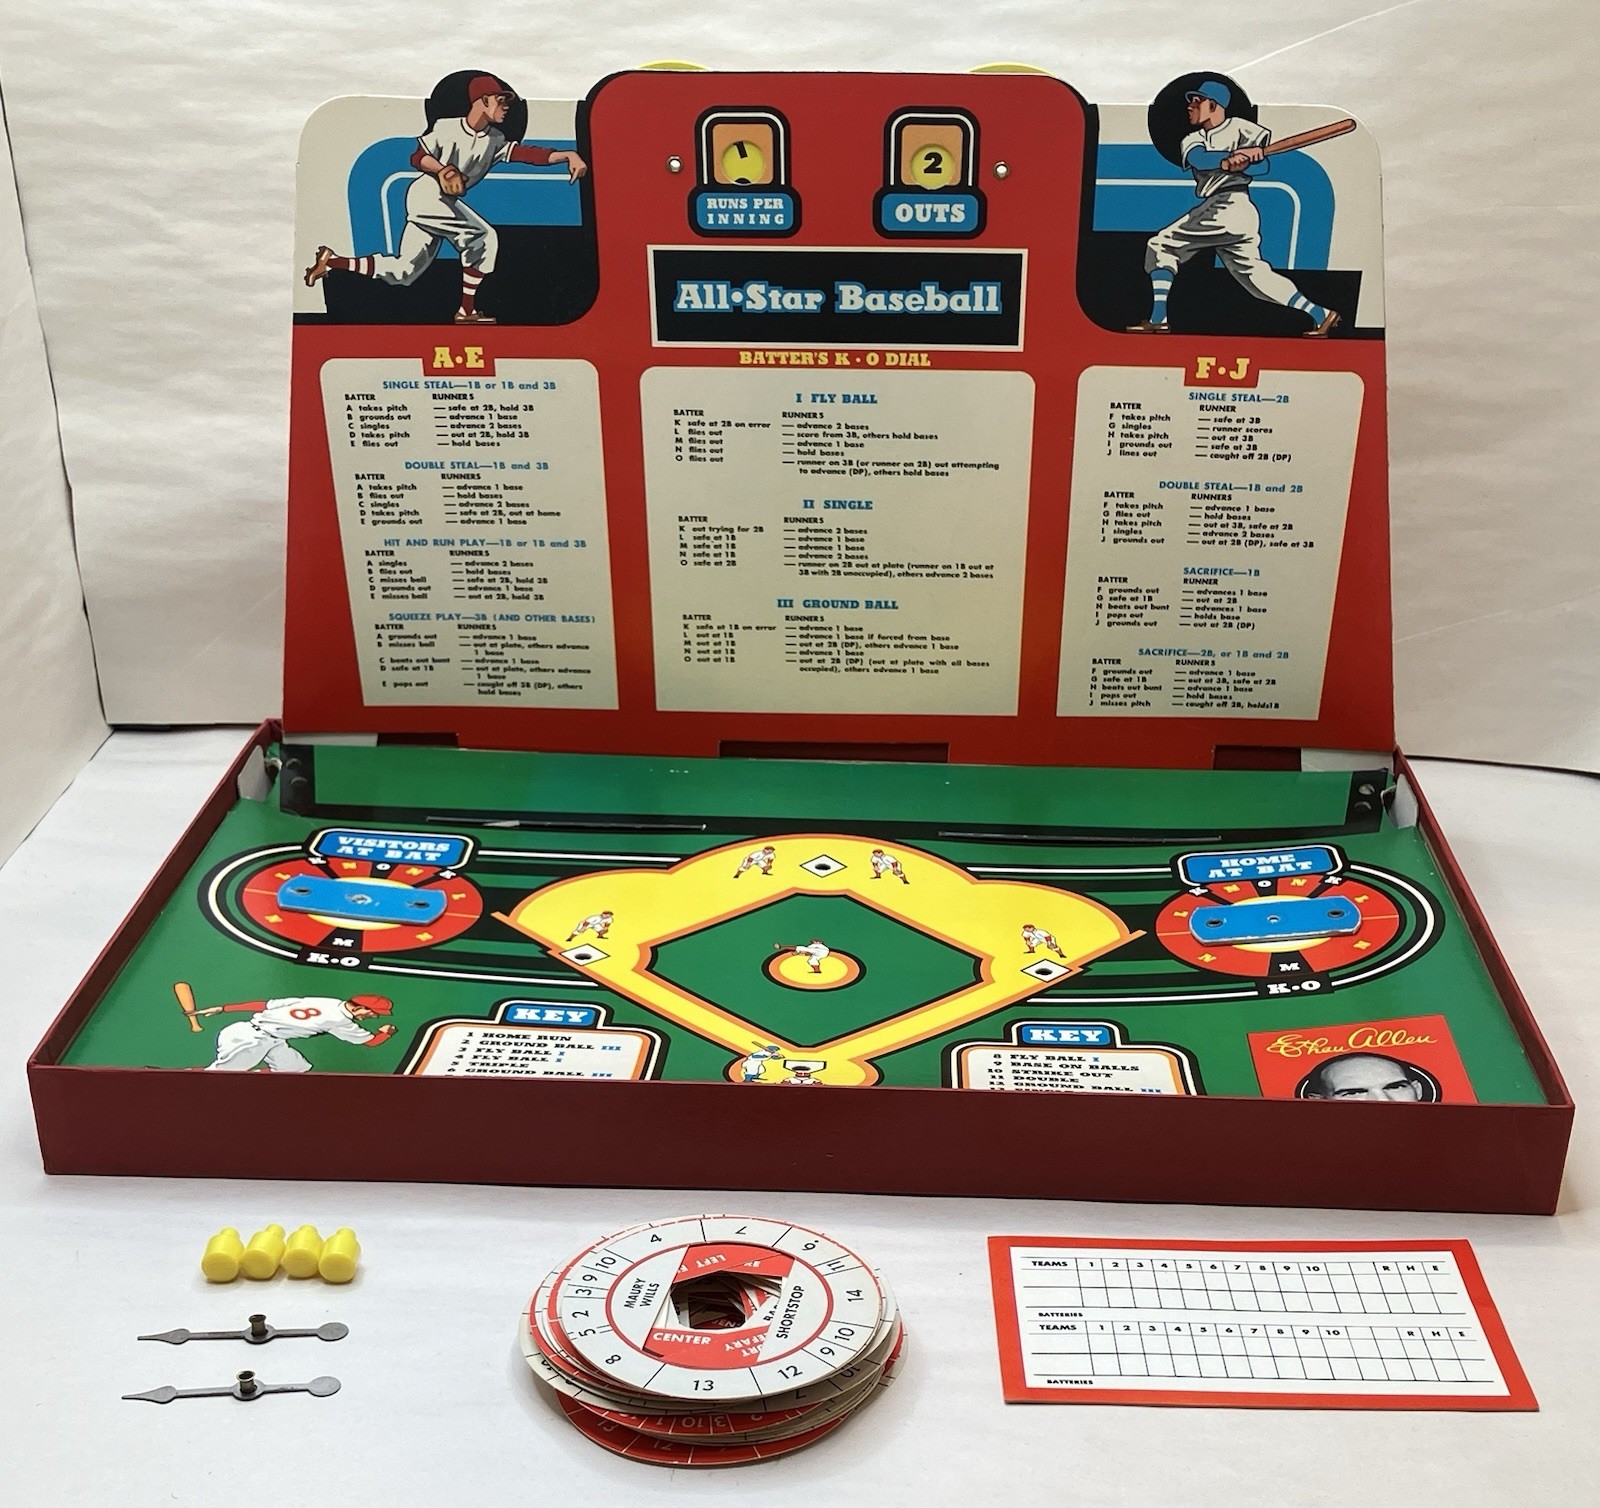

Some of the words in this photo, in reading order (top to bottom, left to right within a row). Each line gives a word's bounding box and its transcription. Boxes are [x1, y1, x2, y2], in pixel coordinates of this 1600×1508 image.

[733, 141, 748, 159] 1
[923, 152, 942, 174] 2
[707, 198, 748, 209] RUNS
[754, 199, 784, 209] PER
[707, 213, 784, 225] INNING
[895, 204, 965, 223] OUTS
[836, 282, 1002, 313] Baseball
[740, 351, 828, 365] BATTER'S
[885, 353, 931, 366] DIAL
[383, 381, 419, 389] SINGLE
[543, 382, 556, 390] 3B
[811, 394, 836, 404] FLY
[842, 394, 878, 404] BALL
[1188, 392, 1226, 401] SINGLE
[1149, 414, 1170, 423] pitch
[511, 462, 530, 470] and
[536, 462, 548, 470] 3B
[1159, 481, 1199, 490] DOUBLE
[1265, 484, 1286, 492] and
[1290, 484, 1303, 492] 2B
[803, 499, 815, 509] II
[824, 500, 873, 510] SINGLE
[433, 539, 455, 547] RUN
[574, 540, 586, 548] 3B
[777, 599, 794, 608] III
[803, 599, 860, 609] GROUND
[865, 600, 898, 609] BALL
[525, 614, 556, 622] OTHER
[1252, 650, 1272, 658] and
[1277, 651, 1289, 659] 2B
[338, 836, 450, 851] VISITORS
[337, 846, 373, 856] AT
[387, 850, 441, 861] BAT
[1220, 854, 1296, 867] HOME
[1209, 869, 1244, 878] AT
[1258, 862, 1313, 874] BAT
[333, 938, 354, 947] M
[1279, 963, 1300, 972] M
[289, 1007, 322, 1021] 8
[514, 1008, 588, 1022] KEY
[1030, 1029, 1103, 1042] KEY
[480, 1040, 548, 1048] GROUND
[1266, 1034, 1350, 1058] Ethan
[1348, 1027, 1439, 1049] Allen
[596, 1257, 616, 1269] 10
[695, 1254, 726, 1268] LEFT
[624, 1278, 646, 1308] MAURY
[640, 1283, 660, 1307] WILLS
[846, 1289, 863, 1302] 14
[572, 1310, 589, 1318] 2
[776, 1286, 804, 1339] SHORTSTOP
[579, 1329, 596, 1337] 5
[653, 1332, 711, 1344] CENTER
[835, 1328, 854, 1341] 10
[606, 1355, 621, 1364] 8
[778, 1366, 802, 1379] 12
[693, 1380, 714, 1391] 13
